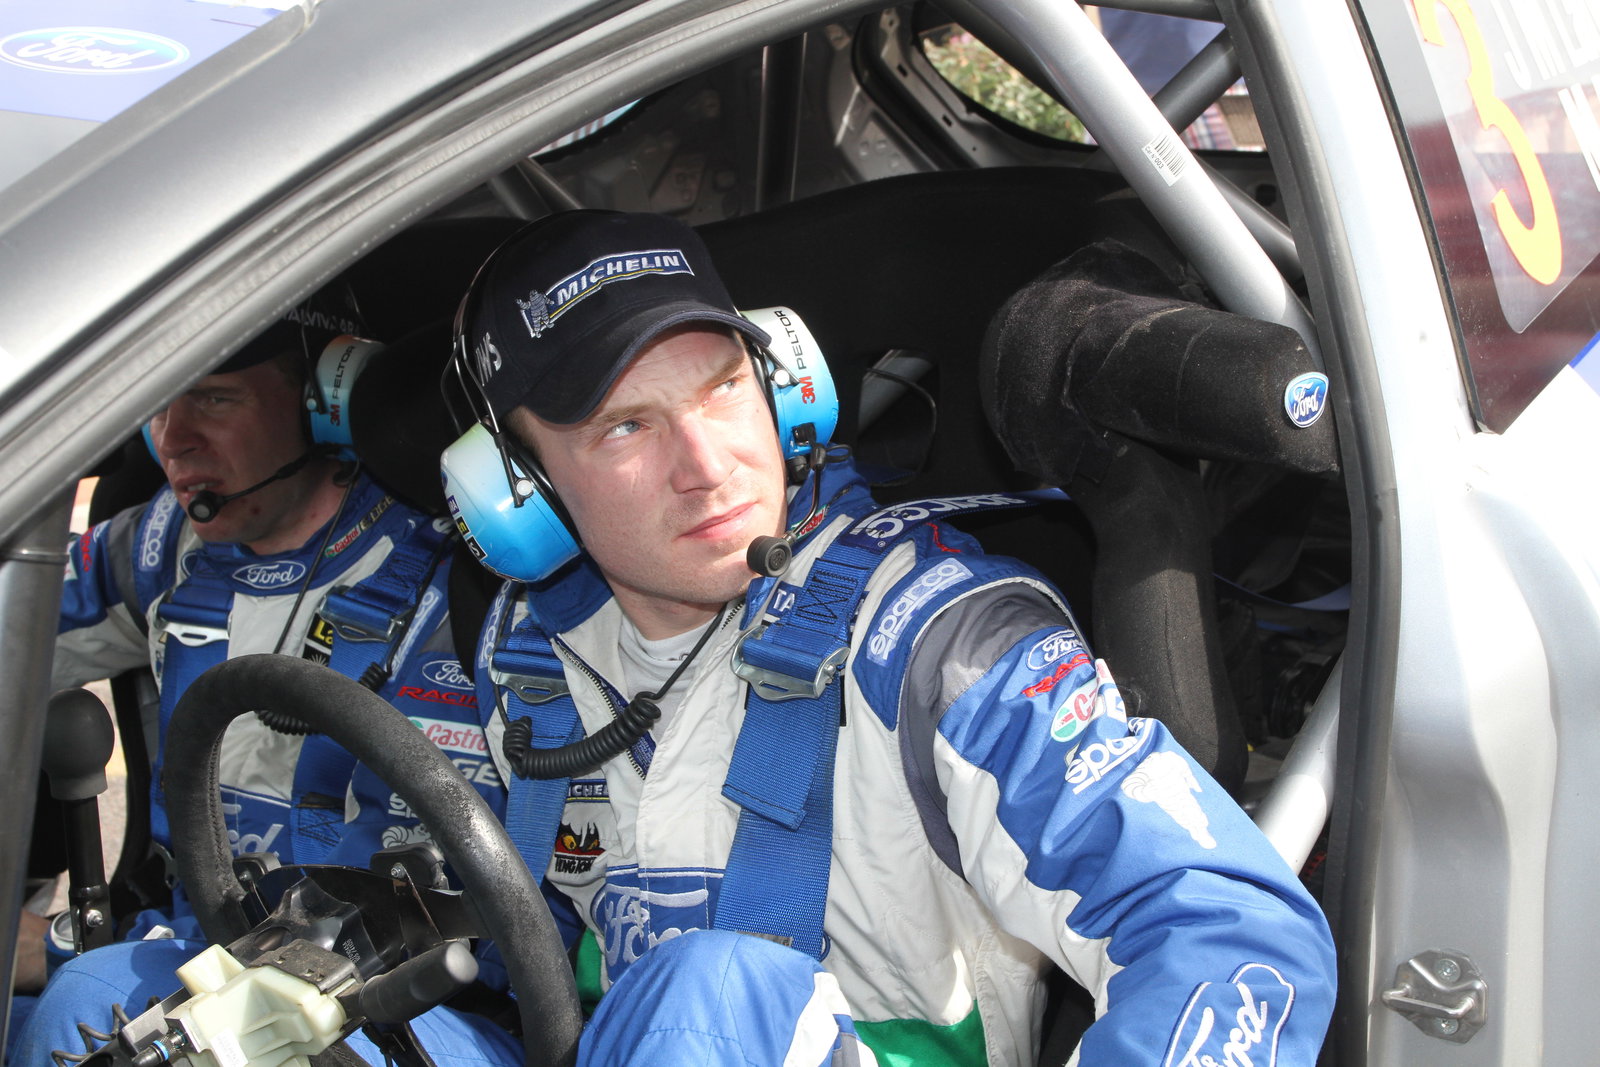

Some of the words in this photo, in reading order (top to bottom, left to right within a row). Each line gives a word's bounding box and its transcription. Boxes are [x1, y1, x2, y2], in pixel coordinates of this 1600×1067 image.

[17, 30, 153, 70] Ford
[556, 255, 681, 306] MICHELIN
[774, 310, 807, 370] PELTOR
[333, 345, 355, 399] PELTOR
[799, 376, 816, 405] 3M
[330, 404, 341, 427] 3M
[1292, 383, 1320, 420] Ford
[334, 526, 360, 553] Castrol
[247, 564, 294, 585] Ford
[870, 563, 964, 661] sparco
